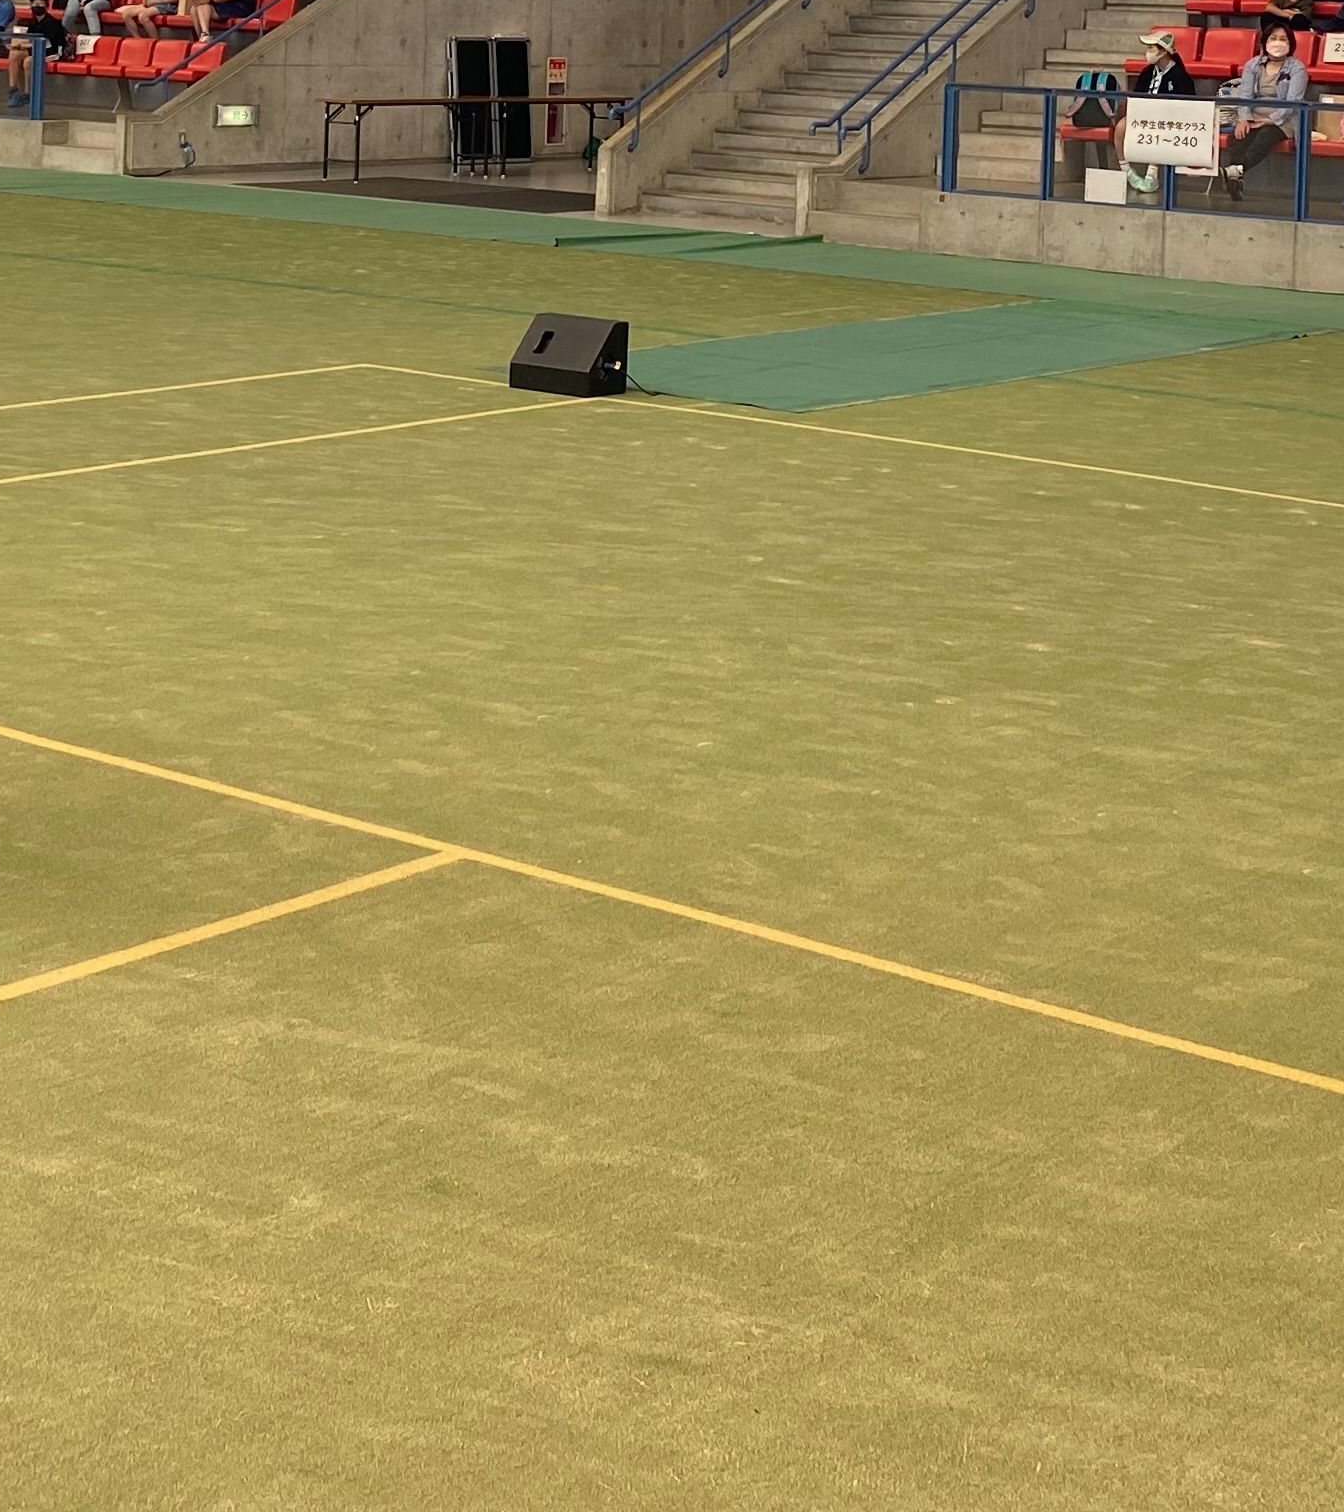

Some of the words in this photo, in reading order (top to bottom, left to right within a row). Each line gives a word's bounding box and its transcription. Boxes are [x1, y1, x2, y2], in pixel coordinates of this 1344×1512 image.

[1131, 119, 1207, 133] 小学生低学年クラス
[1137, 133, 1199, 148] 231～240
